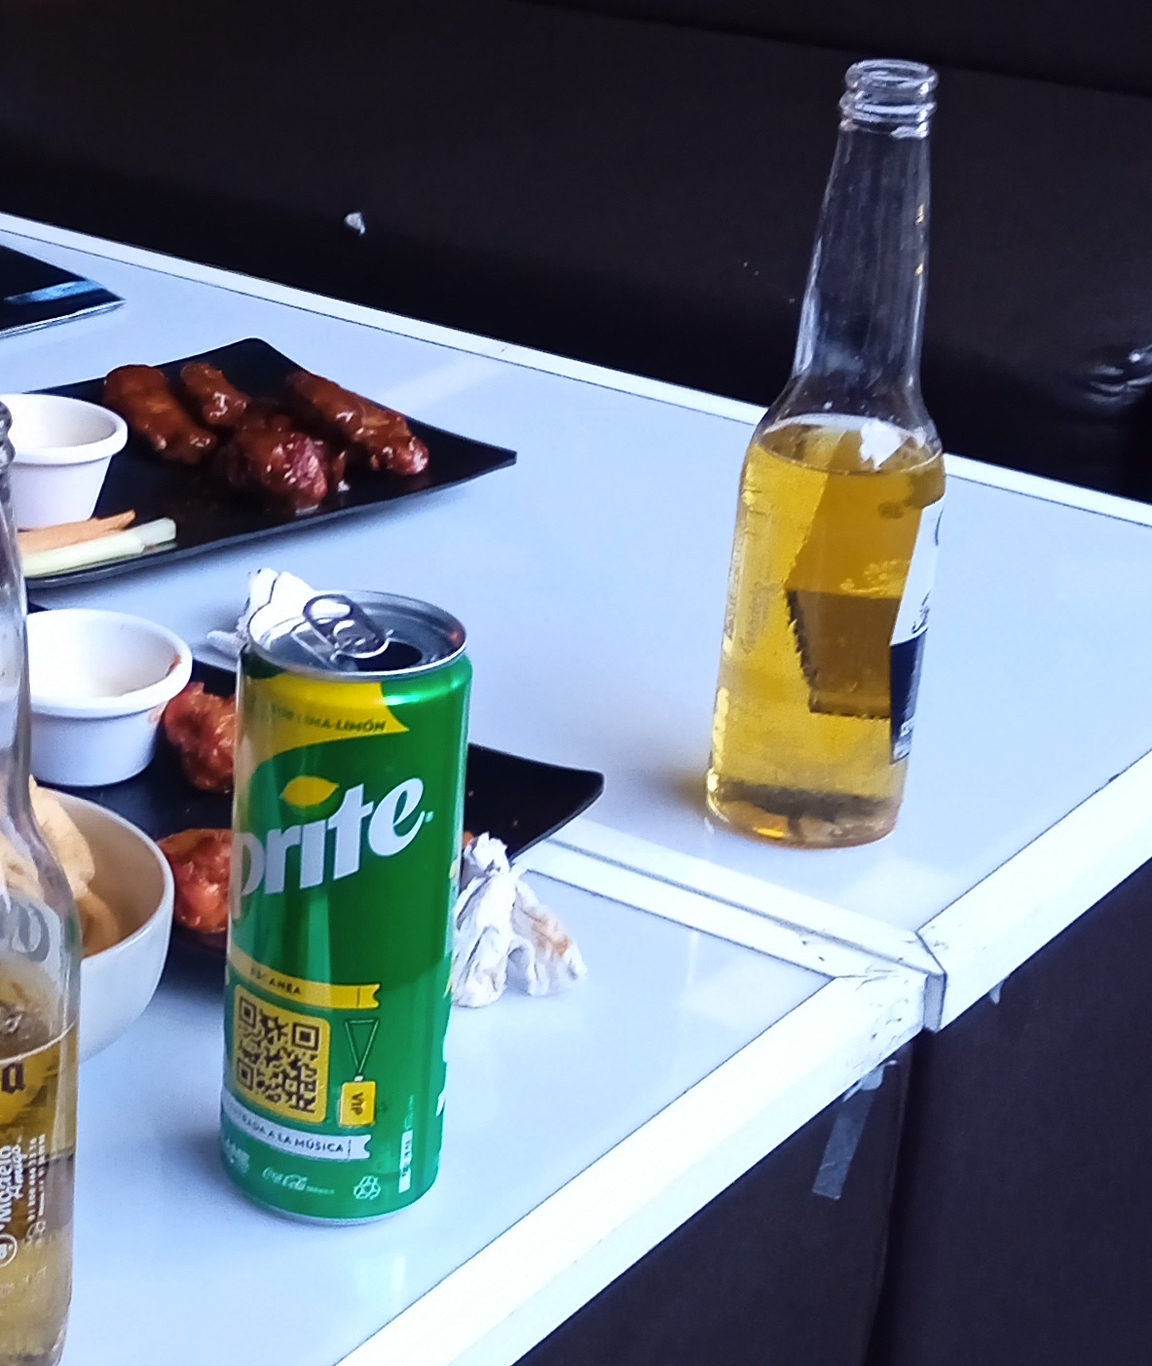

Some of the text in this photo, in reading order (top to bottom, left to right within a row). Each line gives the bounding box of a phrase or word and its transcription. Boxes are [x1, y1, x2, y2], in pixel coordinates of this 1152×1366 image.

[230, 777, 426, 920] prite
[350, 1091, 364, 1116] VIP
[294, 1137, 345, 1153] MÚSICA
[10, 1143, 27, 1200] Amigo
